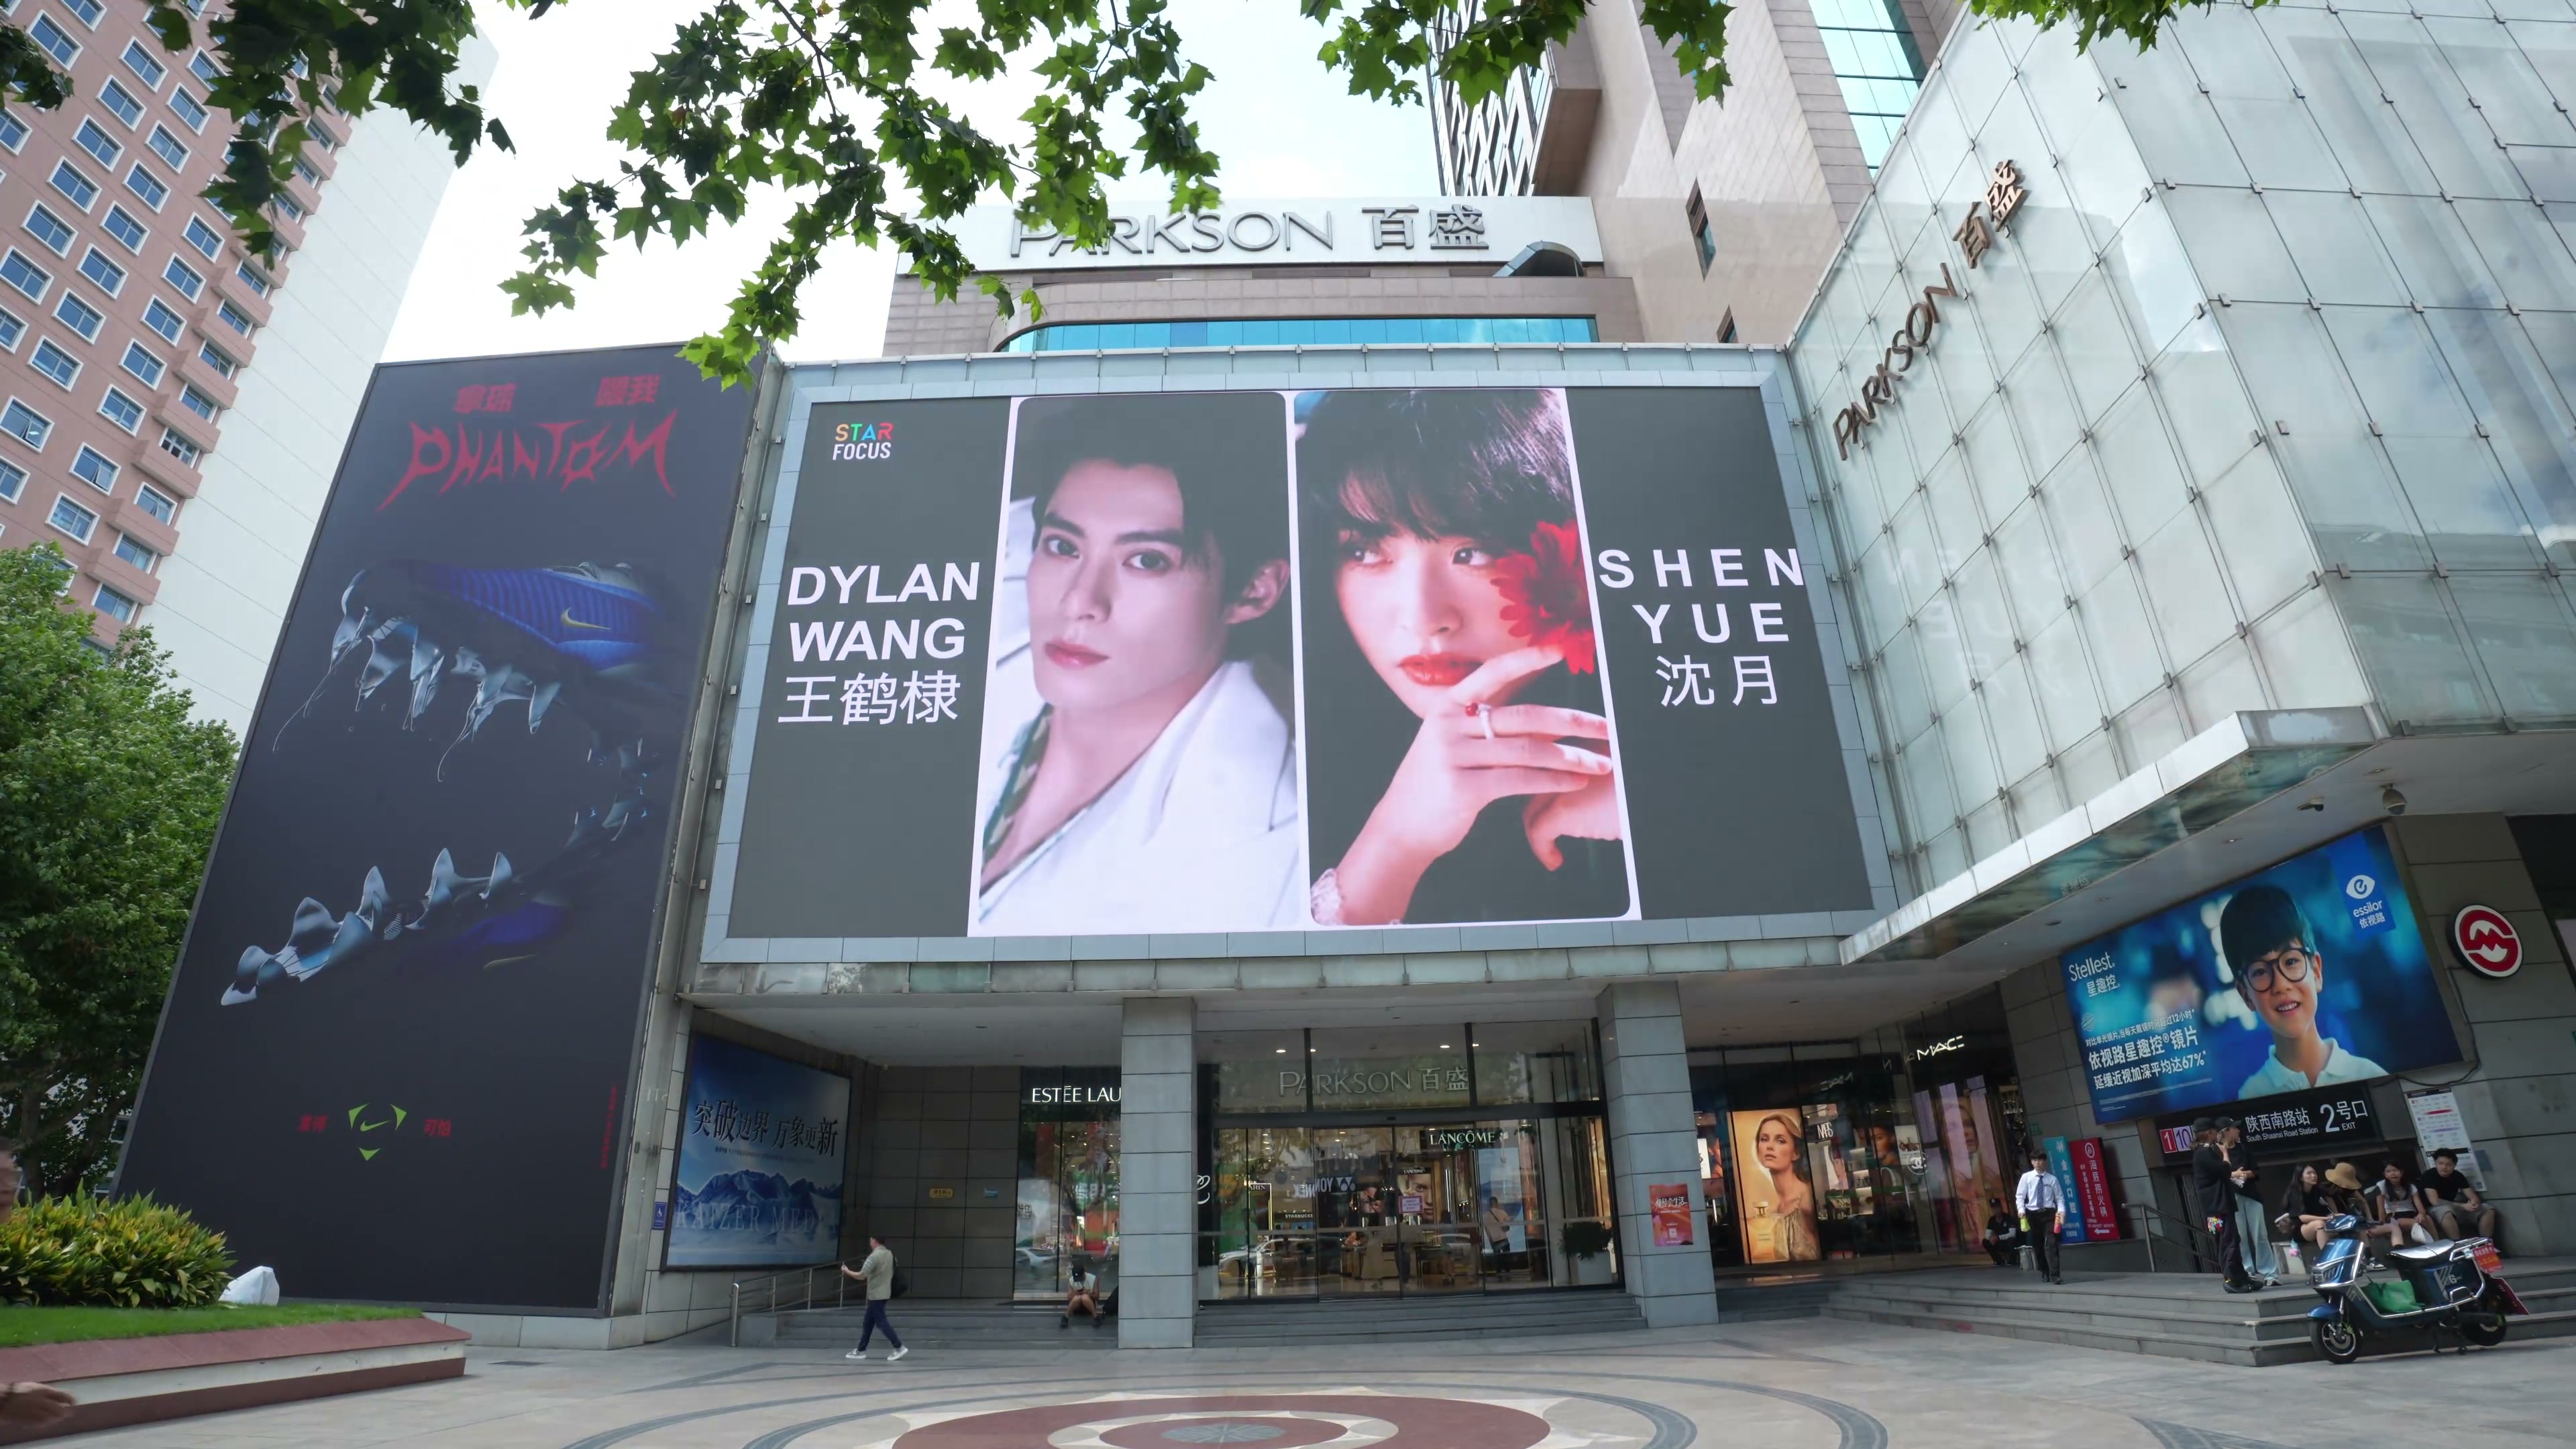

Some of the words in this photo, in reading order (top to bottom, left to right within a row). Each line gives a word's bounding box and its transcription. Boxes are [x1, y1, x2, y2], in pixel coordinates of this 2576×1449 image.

[1362, 203, 1490, 250] 百盛
[1833, 262, 1957, 461] PARKSON
[1952, 159, 2025, 269] 百盛
[835, 422, 894, 442] STAR
[376, 408, 678, 513] PHANTOM
[832, 441, 892, 461] FOCUS
[1597, 547, 1805, 588] SHEN
[787, 561, 980, 606] DYLAN
[1631, 602, 1789, 644] YUE
[789, 617, 965, 662] WANG
[1656, 654, 1778, 706] 沈月
[778, 669, 961, 725] 王鹤棣
[2353, 900, 2383, 918] essilor
[2359, 912, 2385, 928] 依视路
[1417, 1065, 1468, 1091] 百盛
[1032, 1085, 1082, 1102] ESTÉE
[692, 1099, 769, 1143] 突破边界
[771, 1116, 838, 1157] 万象更新
[1817, 1122, 1833, 1140] NARS
[2245, 1108, 2310, 1133] 陕西南路站
[2342, 1122, 2356, 1131] EXIT
[1429, 1130, 1496, 1146] LANCÔME
[2164, 1131, 2173, 1150] 1
[2176, 1128, 2192, 1149] 10
[2246, 1134, 2262, 1142] South
[2262, 1131, 2283, 1140] Shaanxi
[2283, 1129, 2298, 1138] Road
[2298, 1127, 2319, 1136] Station
[2088, 1159, 2108, 1218] 海底捞火锅
